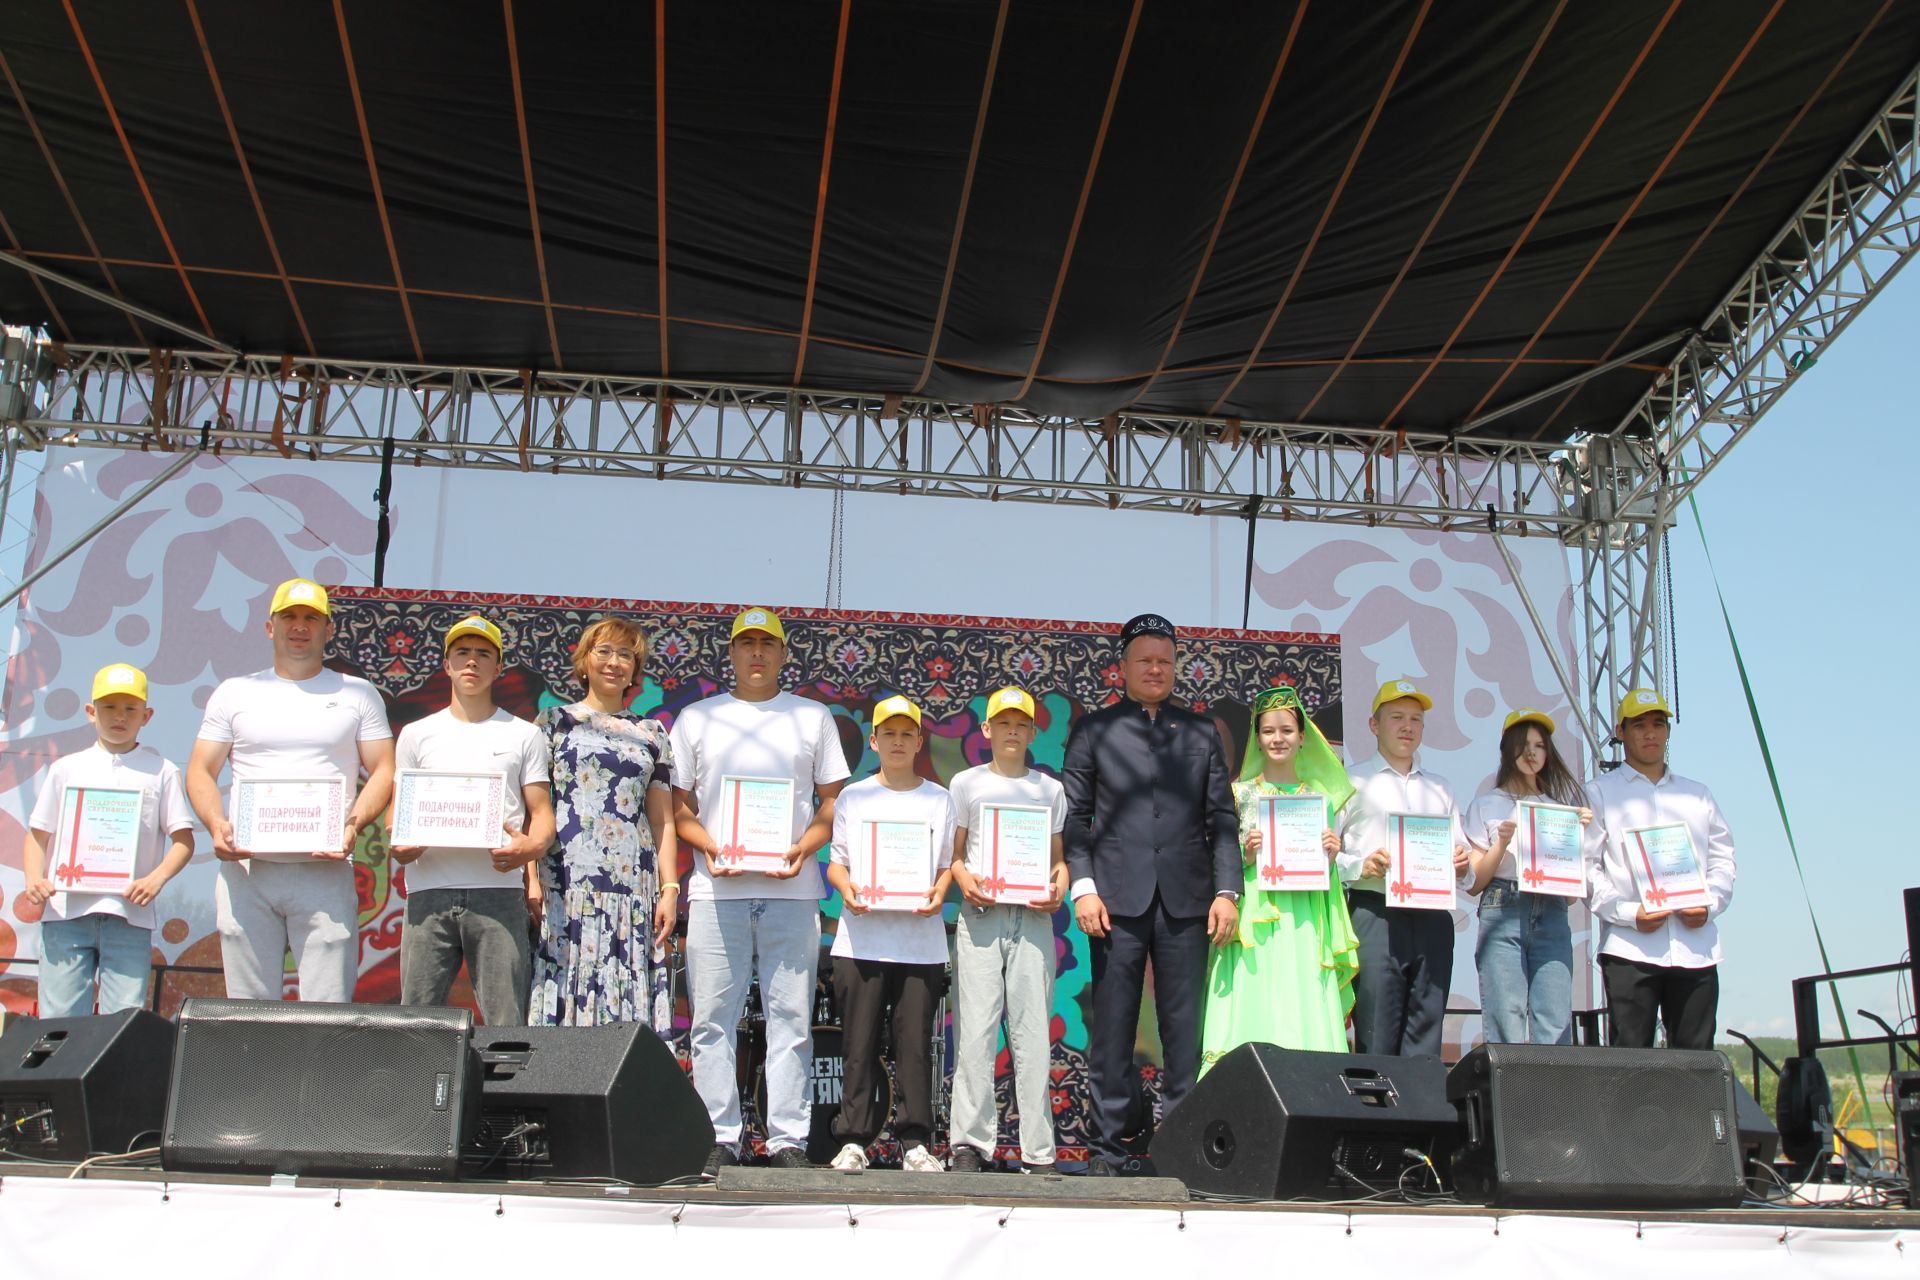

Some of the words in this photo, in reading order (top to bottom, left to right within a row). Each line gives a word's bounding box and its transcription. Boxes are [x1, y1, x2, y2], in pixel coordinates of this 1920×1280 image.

[259, 806, 321, 818] ПОДАРОЧНЫЙ
[419, 801, 481, 814] ПОДАРОЧНЫЙ
[258, 822, 320, 833] СЕРТИФИКАТ
[418, 816, 480, 828] СЕРТИФИКАТ
[1713, 1114, 1722, 1140] QSC
